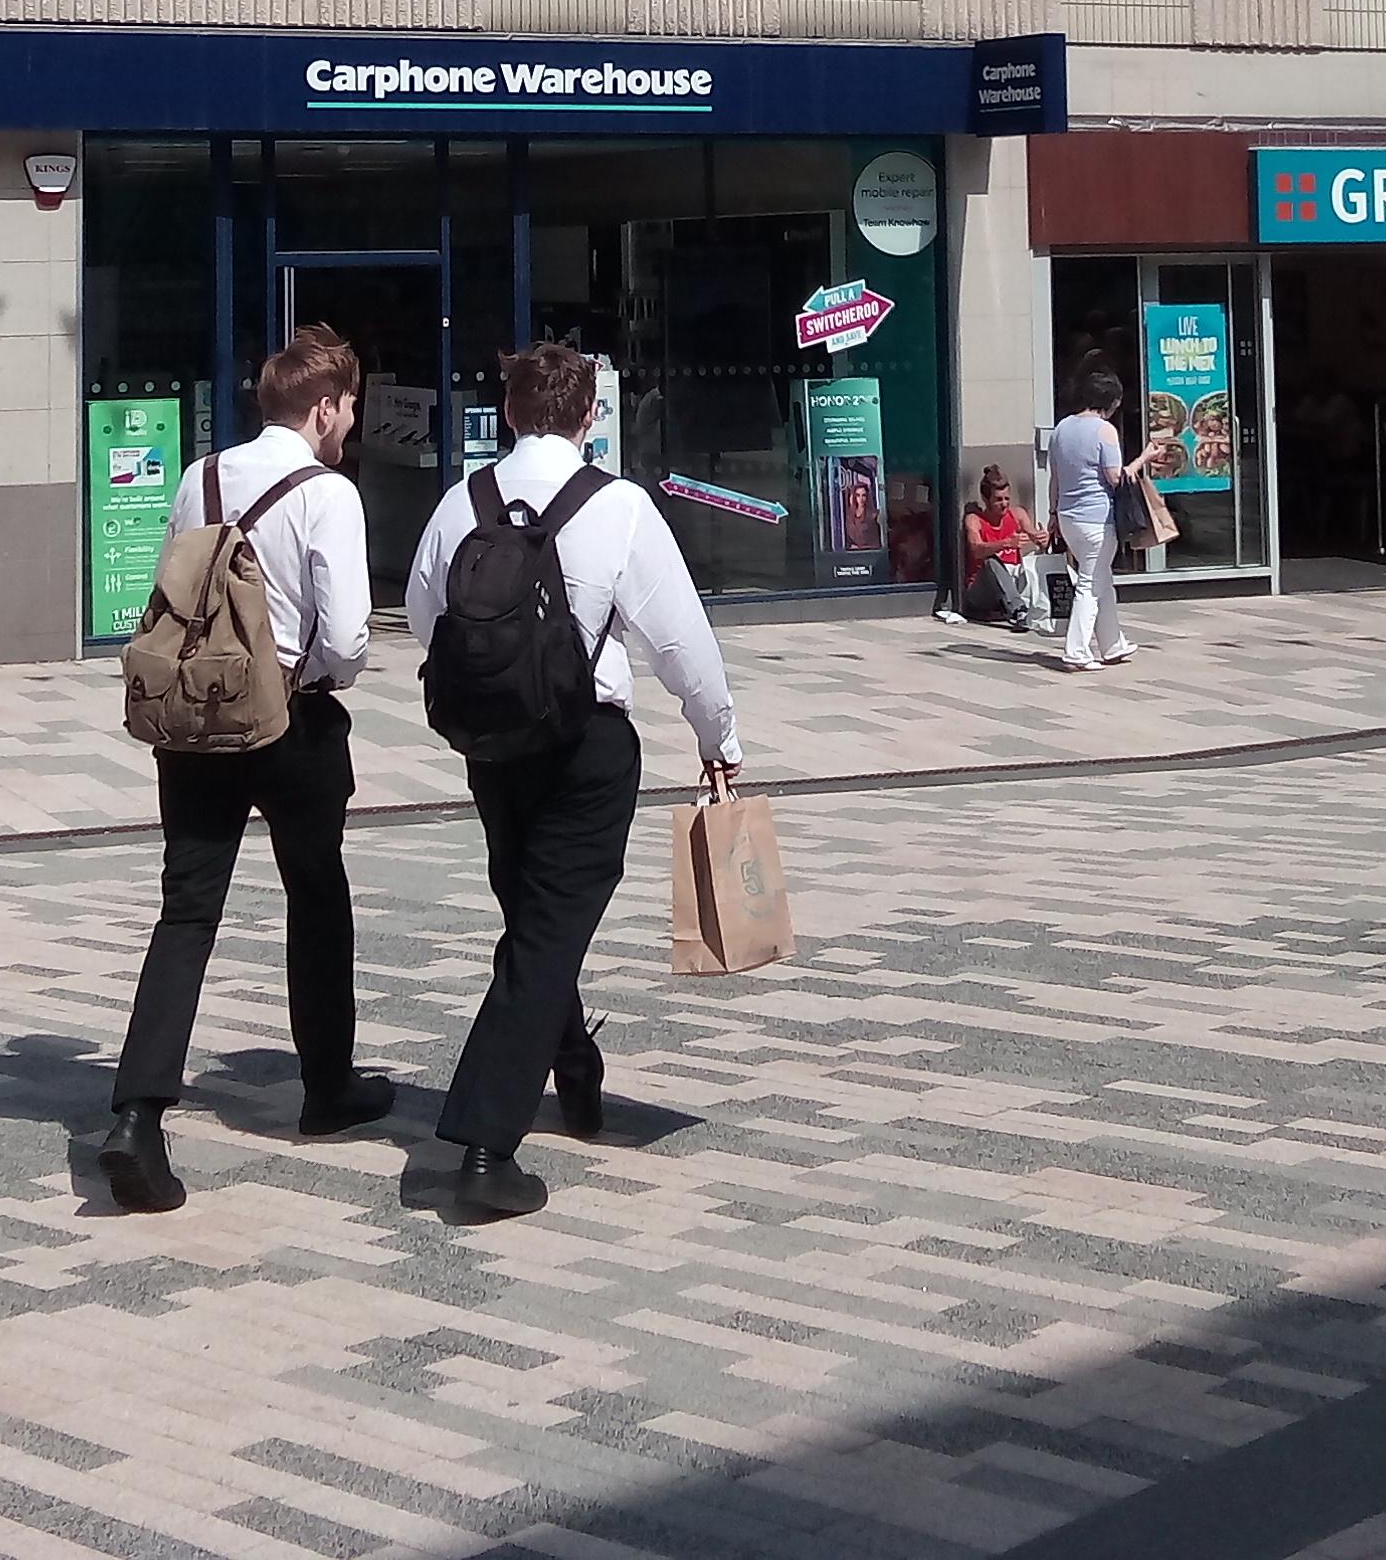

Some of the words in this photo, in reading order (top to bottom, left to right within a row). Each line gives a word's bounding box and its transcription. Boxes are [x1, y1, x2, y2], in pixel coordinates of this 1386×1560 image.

[306, 59, 497, 99] Carphone
[500, 62, 713, 96] Warehouse
[982, 62, 1036, 83] Carphone
[978, 85, 1042, 104] Warehouse
[35, 164, 71, 173] KINGS
[878, 172, 915, 184] Expert
[824, 291, 848, 308] PULL
[848, 288, 856, 301] A
[806, 301, 880, 336] SWITCHEROO
[1178, 316, 1199, 336] LIVE
[1160, 337, 1200, 355] LUNCH
[1163, 355, 1188, 372] THE
[811, 395, 852, 408] HONOR
